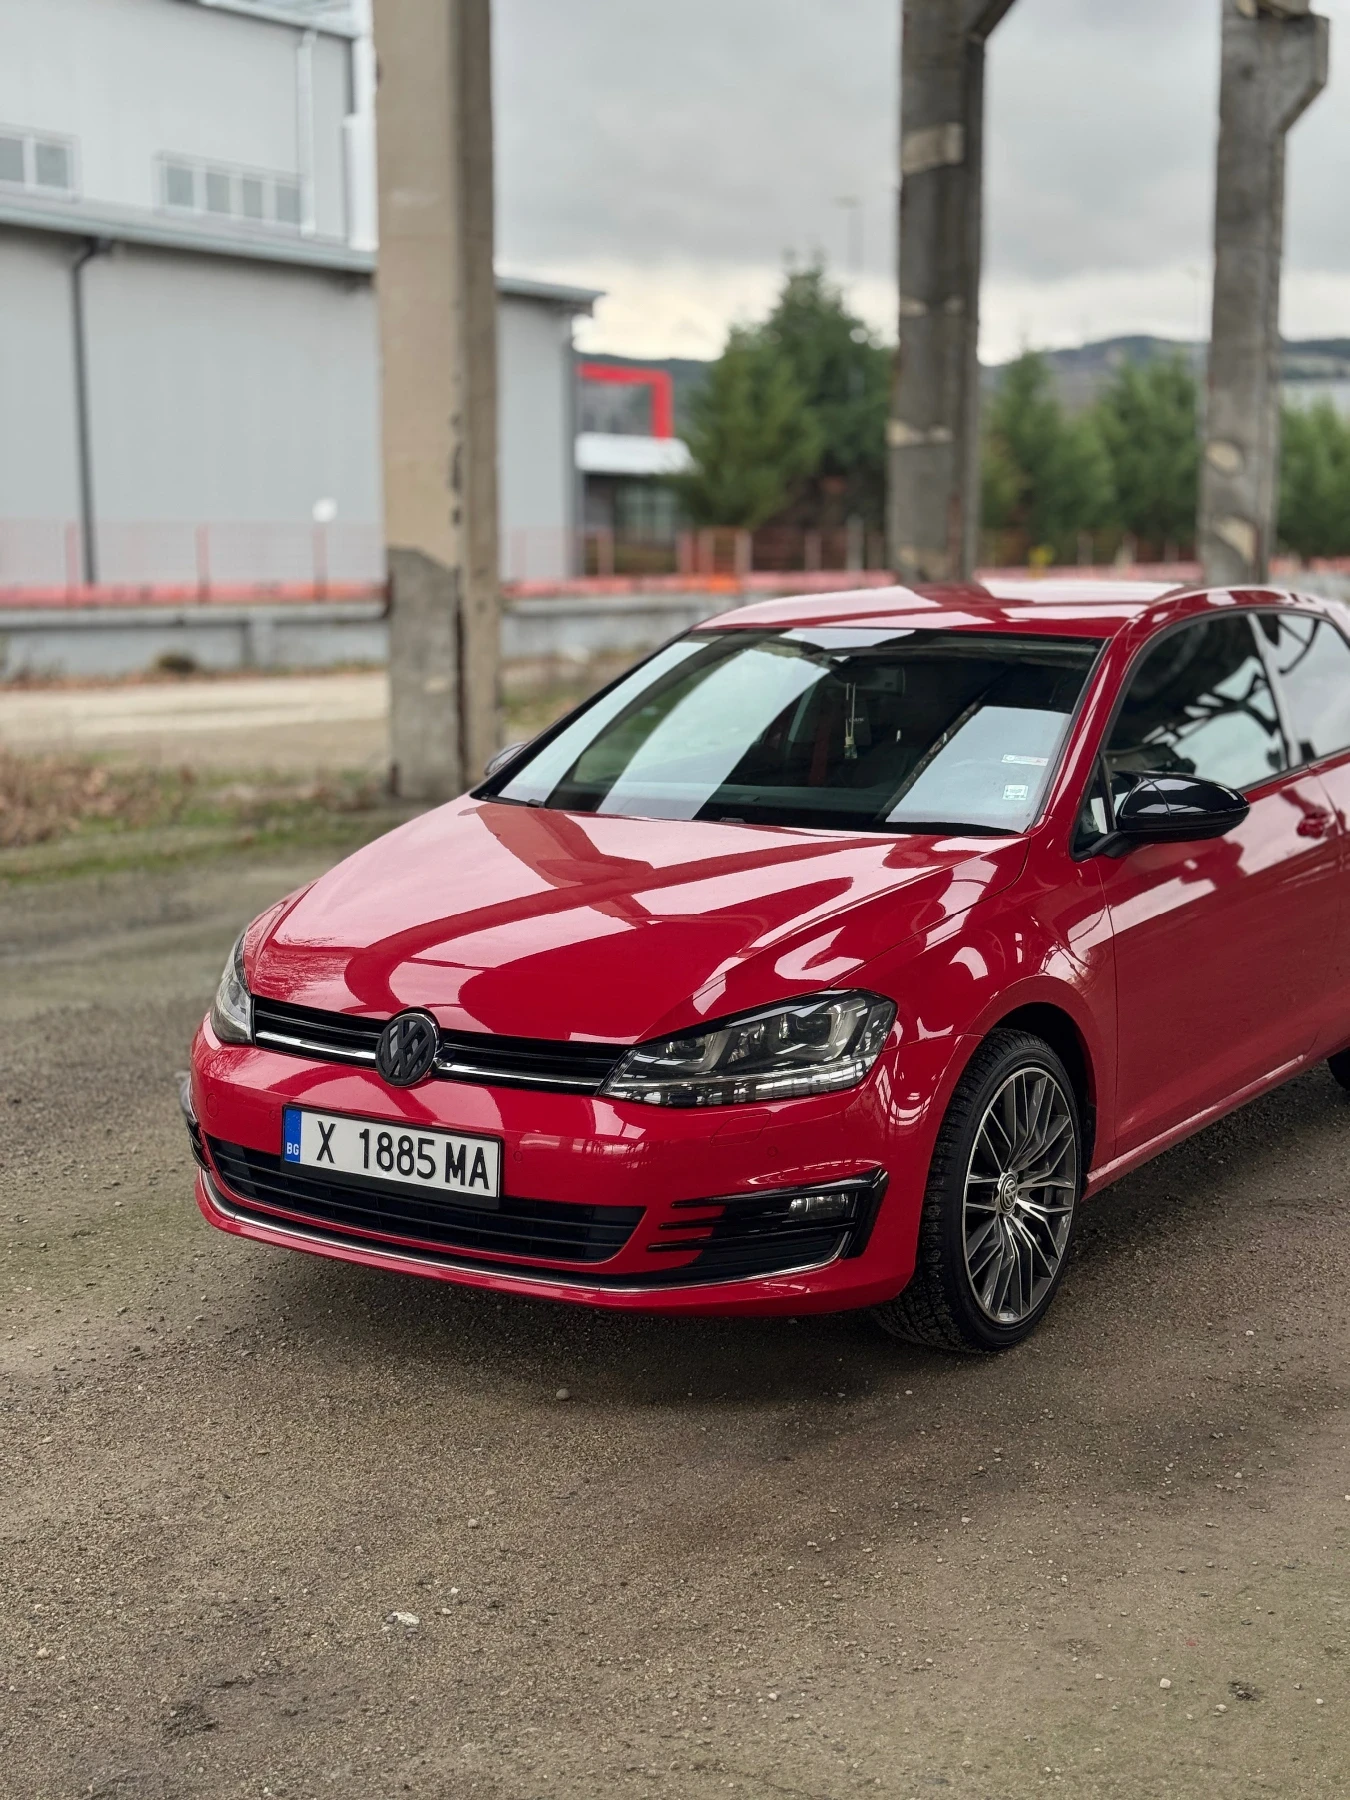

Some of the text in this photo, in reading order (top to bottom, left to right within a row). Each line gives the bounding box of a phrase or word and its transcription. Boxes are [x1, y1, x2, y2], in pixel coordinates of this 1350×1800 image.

[376, 1015, 436, 1087] VW
[286, 1142, 300, 1156] BG
[316, 1120, 490, 1190] X 1885 MA
